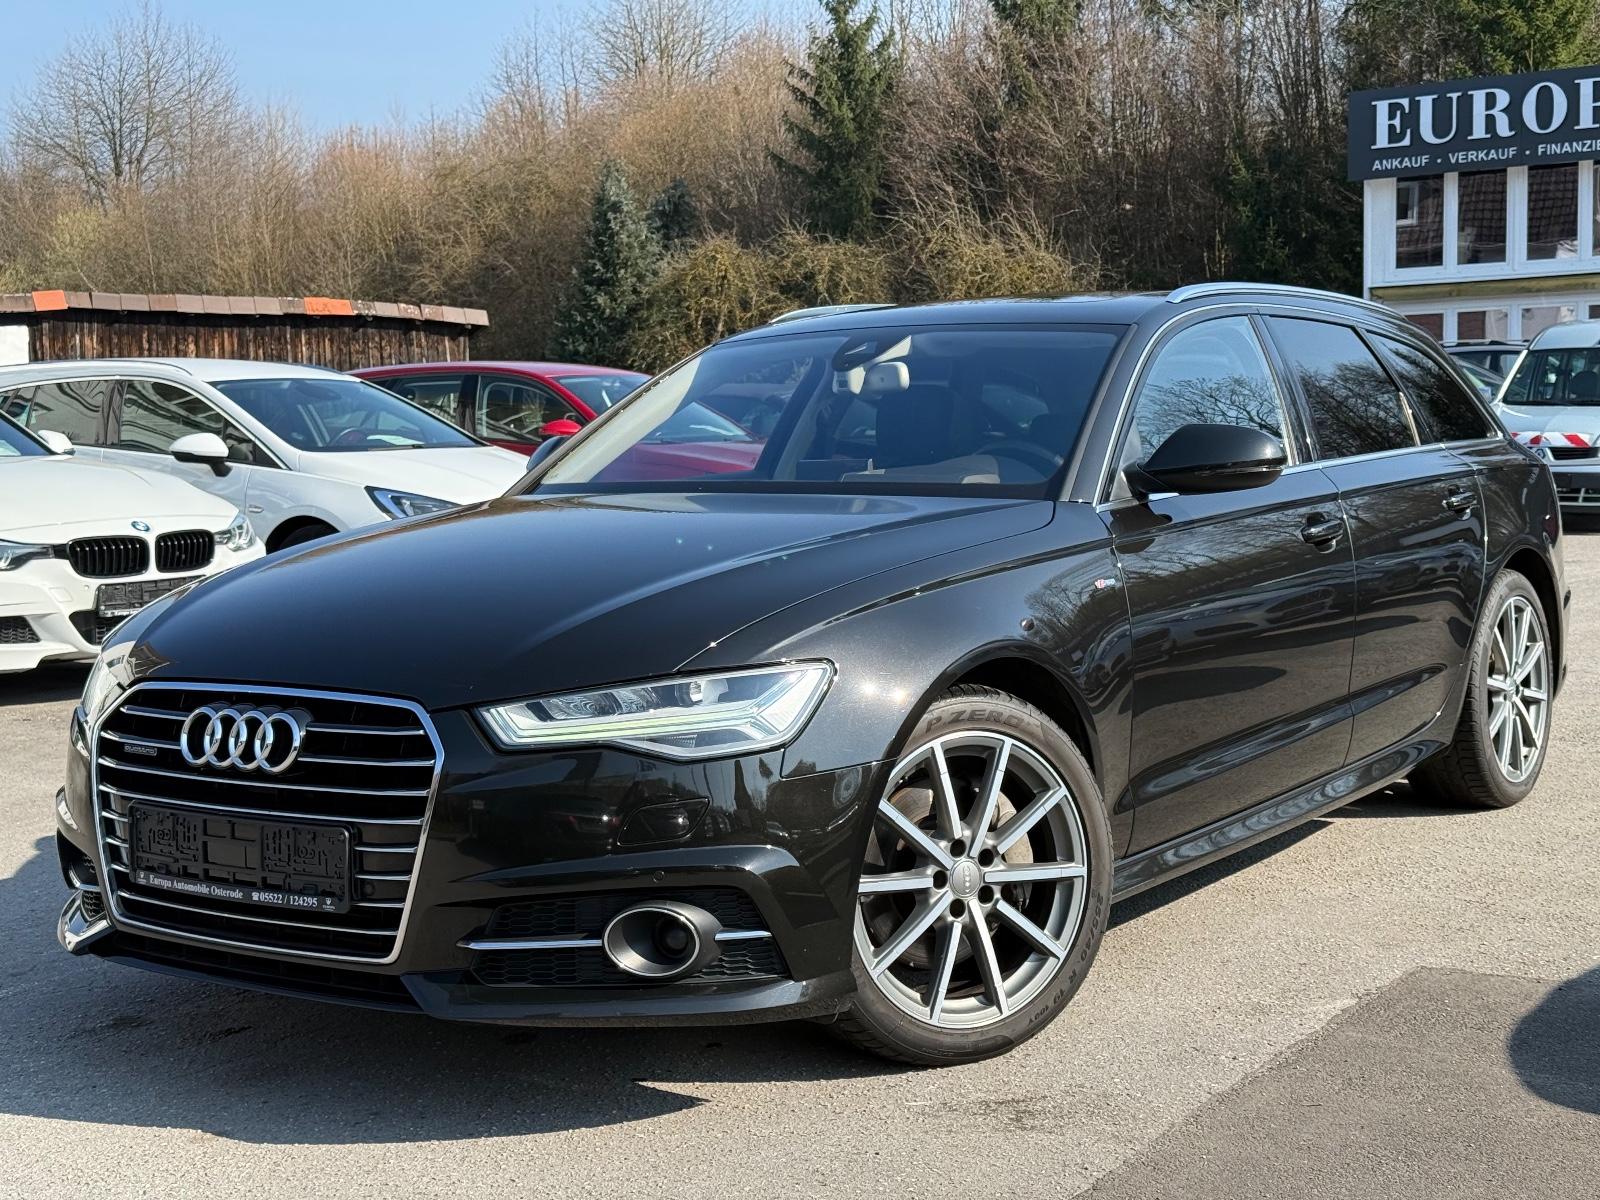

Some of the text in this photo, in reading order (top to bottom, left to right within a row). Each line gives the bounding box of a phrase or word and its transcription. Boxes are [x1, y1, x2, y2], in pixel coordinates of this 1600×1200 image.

[1371, 154, 1430, 172] ANKAUF
[1448, 146, 1518, 164] VERKAUF
[947, 709, 1025, 729] ZERO
[149, 874, 172, 889] Europa
[173, 880, 210, 895] Automobile
[211, 885, 244, 899] Osterode
[289, 895, 318, 907] 124295
